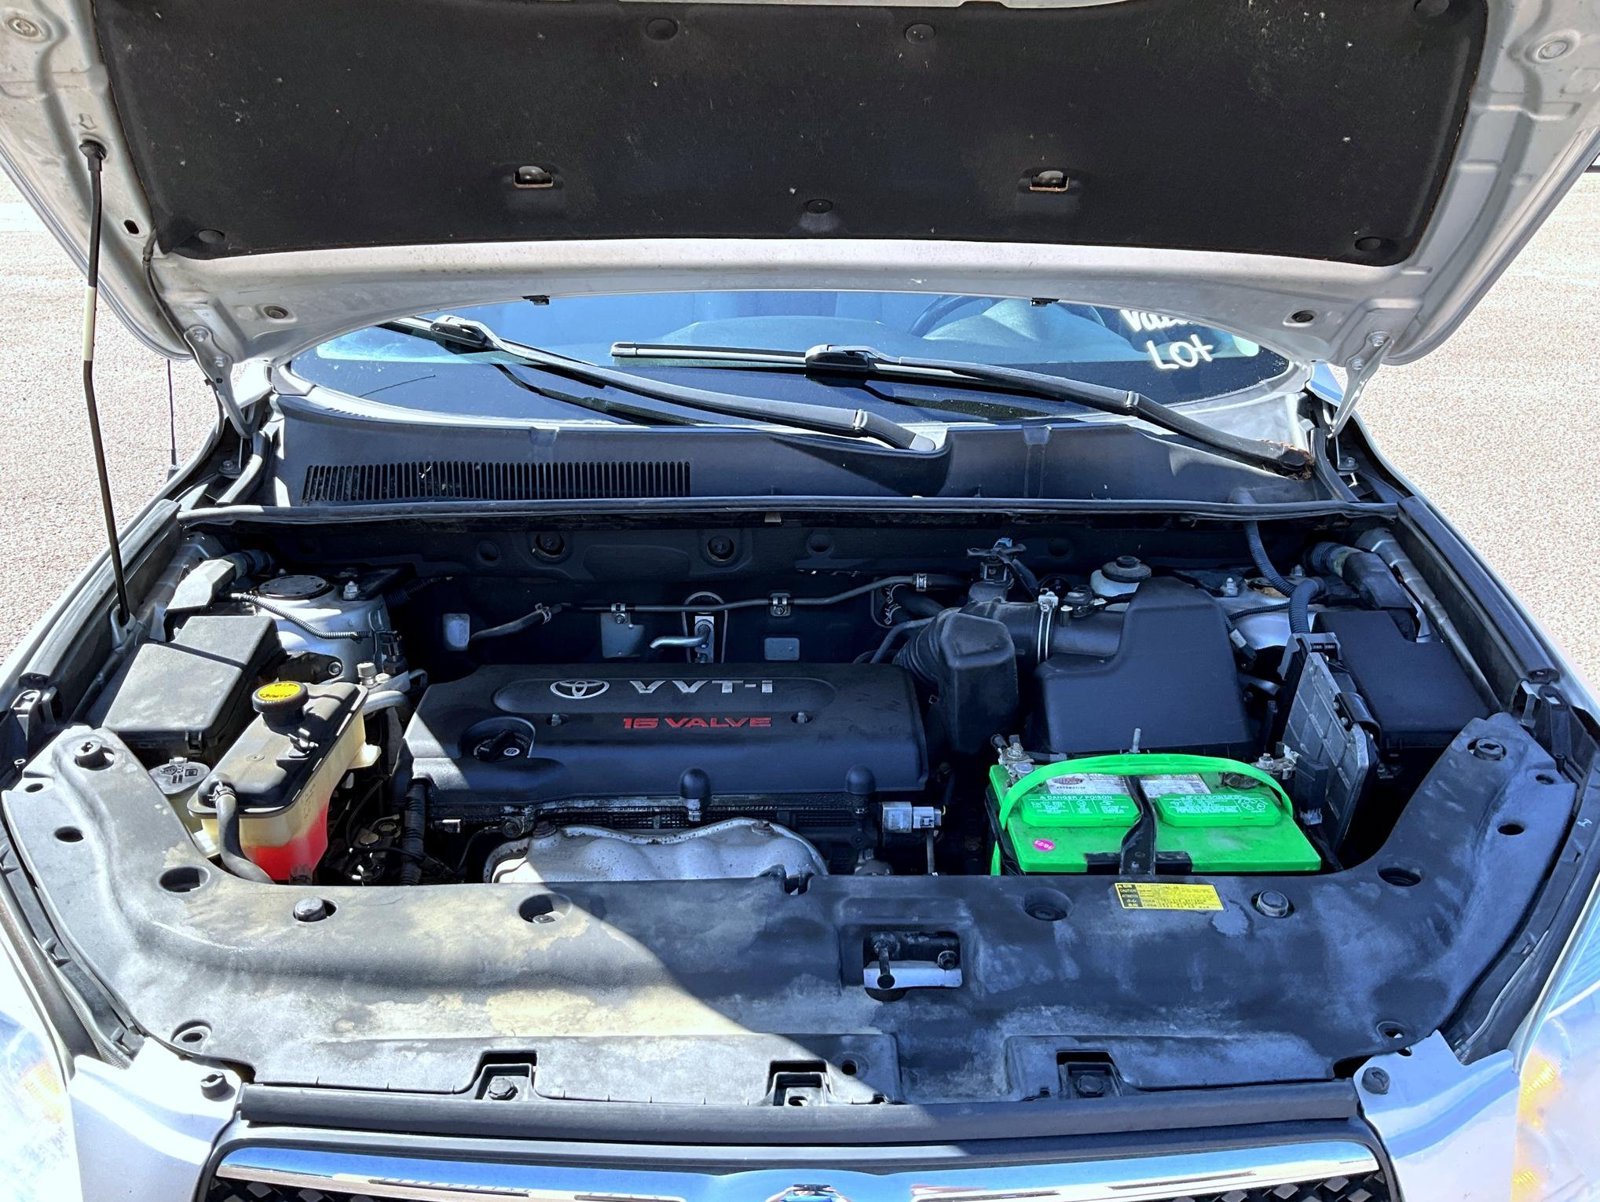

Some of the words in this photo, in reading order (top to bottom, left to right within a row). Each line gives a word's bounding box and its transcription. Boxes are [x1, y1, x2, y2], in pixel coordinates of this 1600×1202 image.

[629, 680, 773, 694] VVT-i
[623, 717, 659, 729] 16
[664, 717, 772, 728] VALVE
